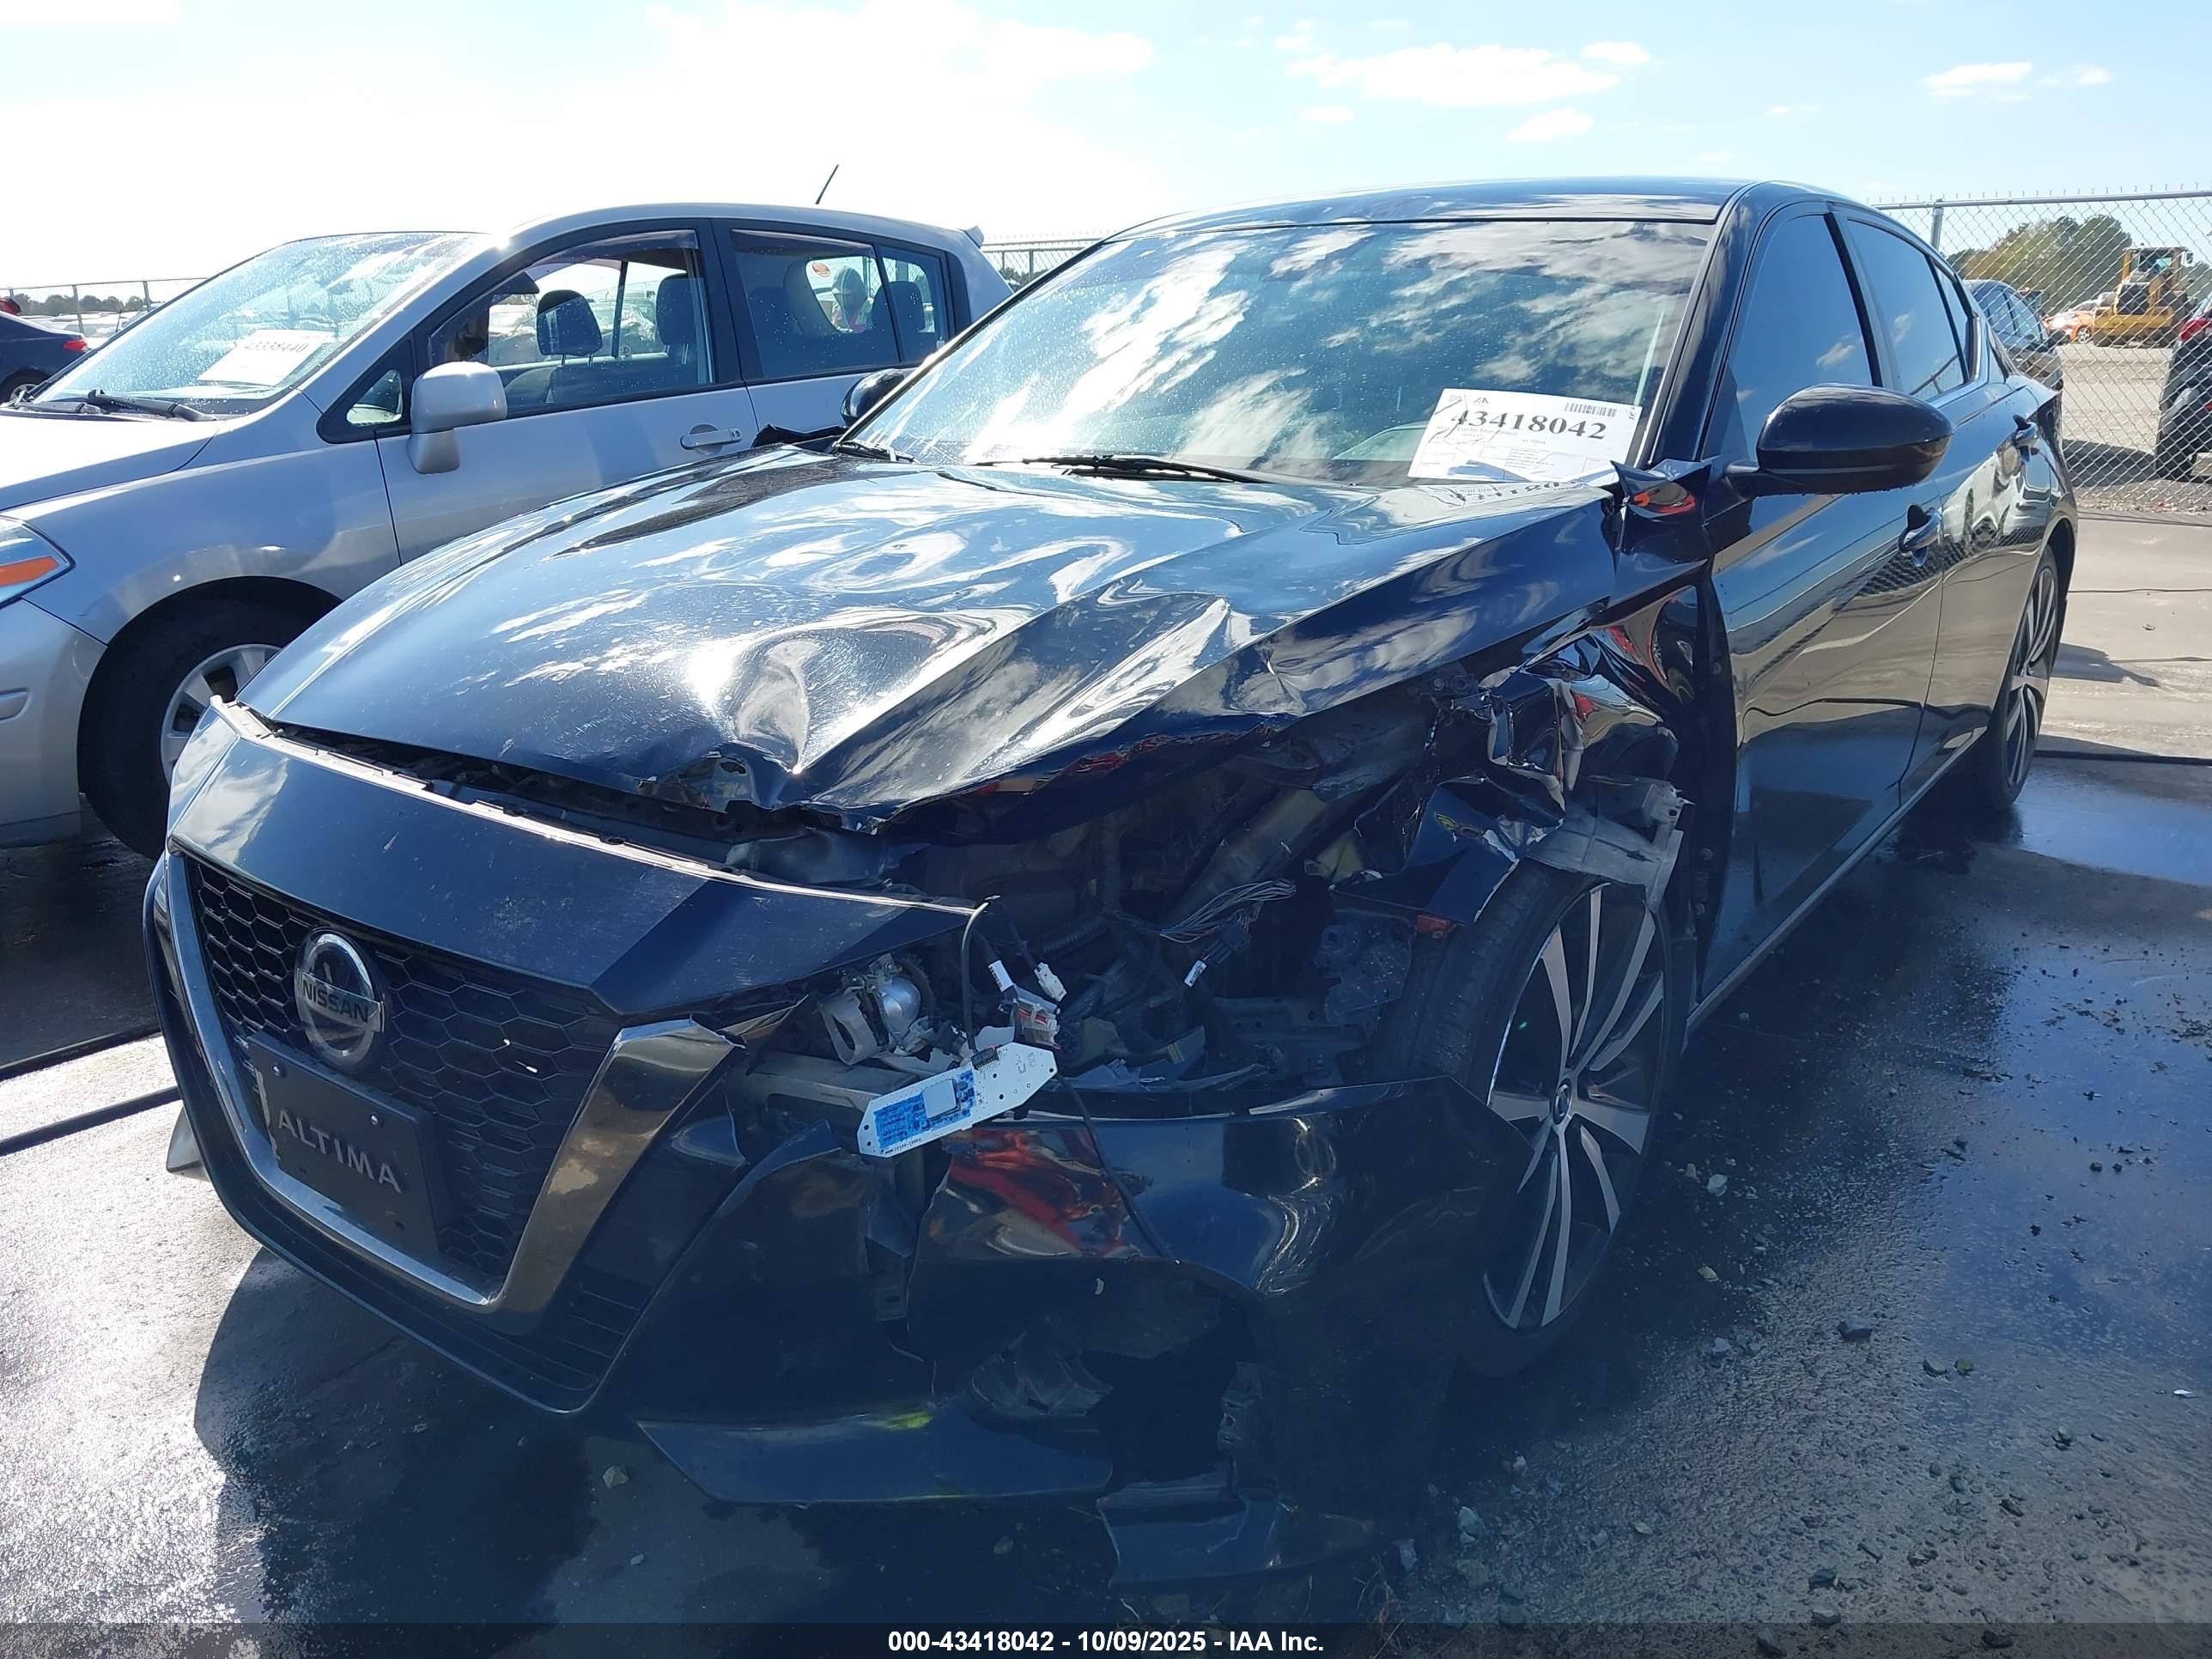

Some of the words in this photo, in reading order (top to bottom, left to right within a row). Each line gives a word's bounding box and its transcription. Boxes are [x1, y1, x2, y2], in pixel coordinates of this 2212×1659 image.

[1451, 410, 1607, 440] 43418042
[302, 980, 369, 1024] NISSAN
[277, 1109, 402, 1194] ALTIMA
